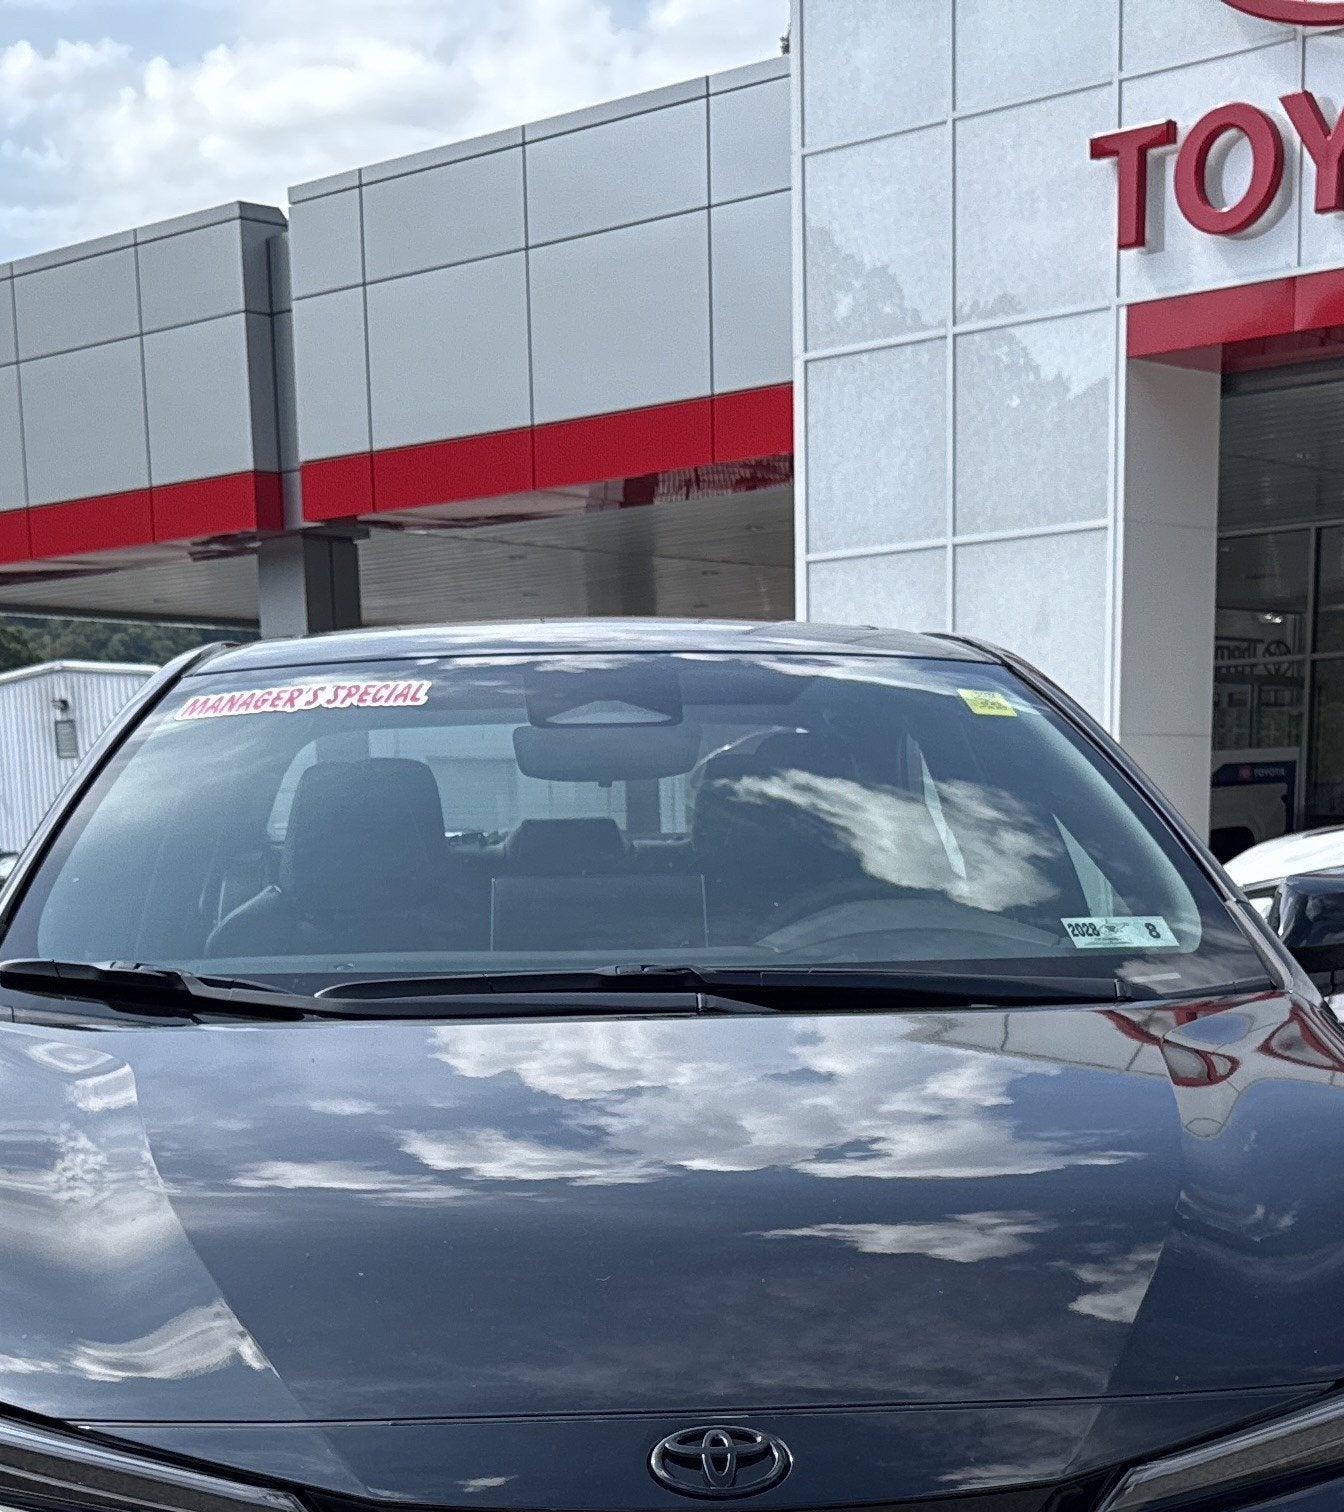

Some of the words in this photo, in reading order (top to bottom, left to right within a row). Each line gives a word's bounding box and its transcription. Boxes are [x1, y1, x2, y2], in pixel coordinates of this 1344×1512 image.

[181, 686, 327, 717] MANAGER'S
[325, 683, 425, 705] SPECIAL
[1067, 922, 1100, 937] 2028
[1144, 922, 1161, 939] 8
